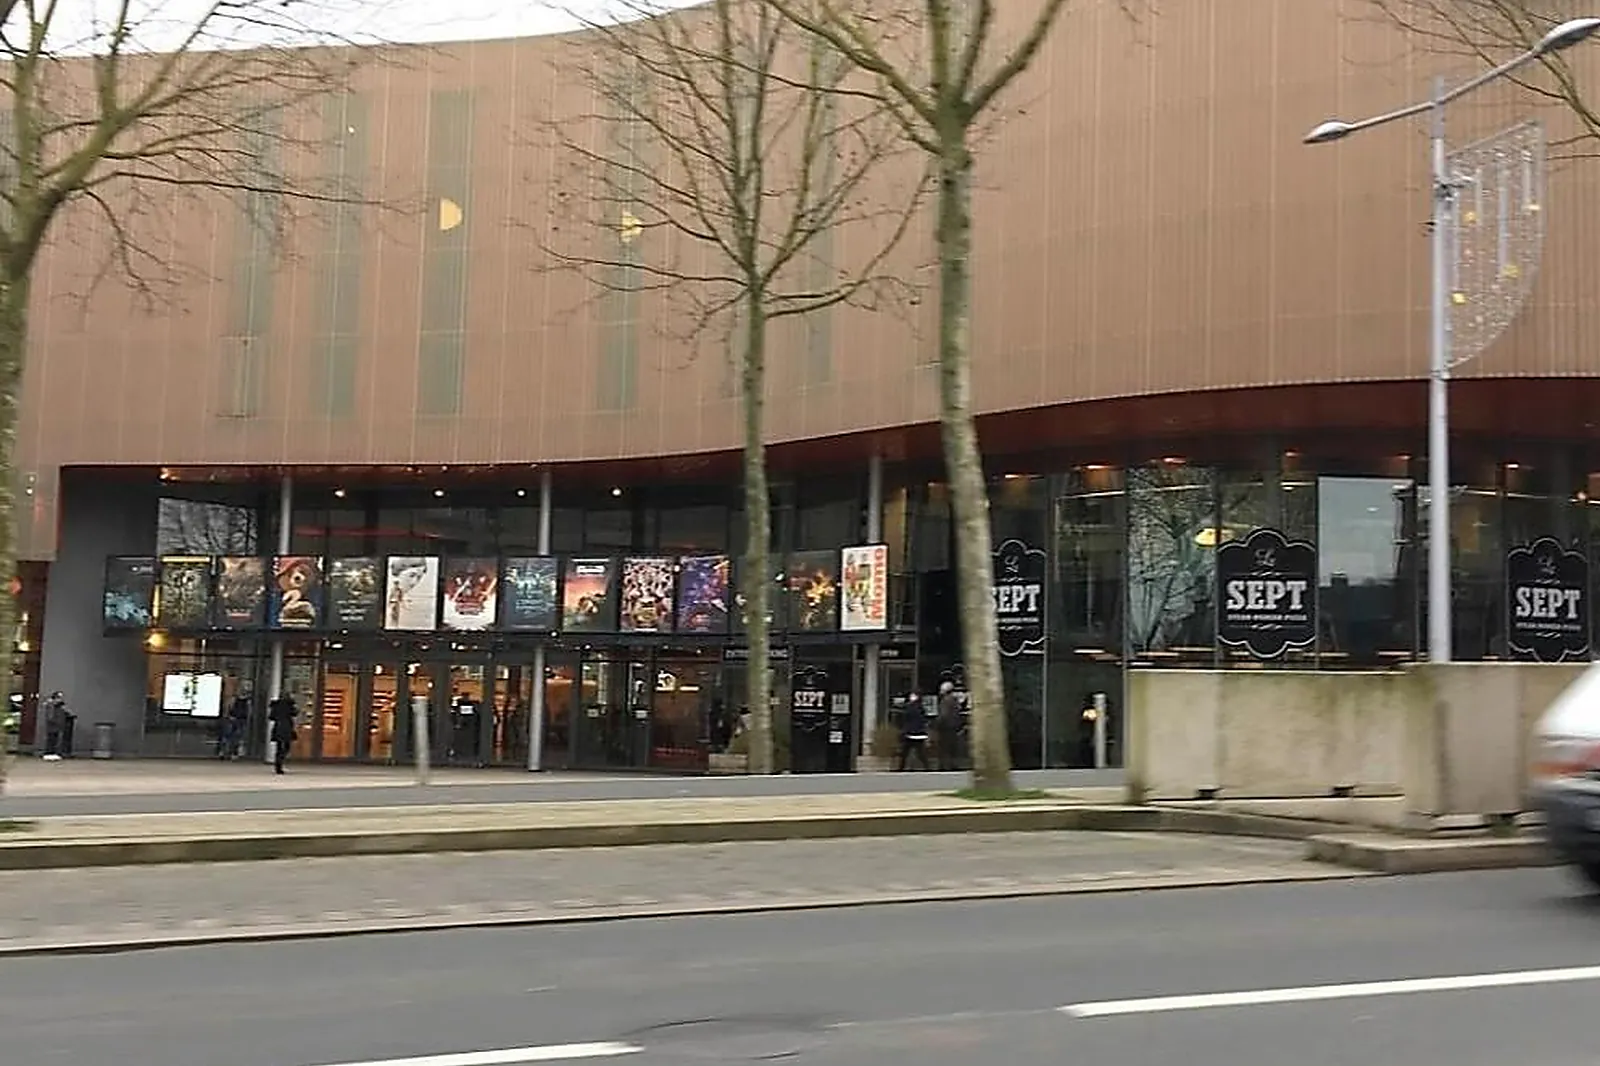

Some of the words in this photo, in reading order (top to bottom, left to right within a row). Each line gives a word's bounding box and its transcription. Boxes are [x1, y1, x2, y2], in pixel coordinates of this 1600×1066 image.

[1226, 580, 1308, 610] SEPT
[1516, 586, 1582, 619] SEPT
[793, 691, 825, 708] SEPT
